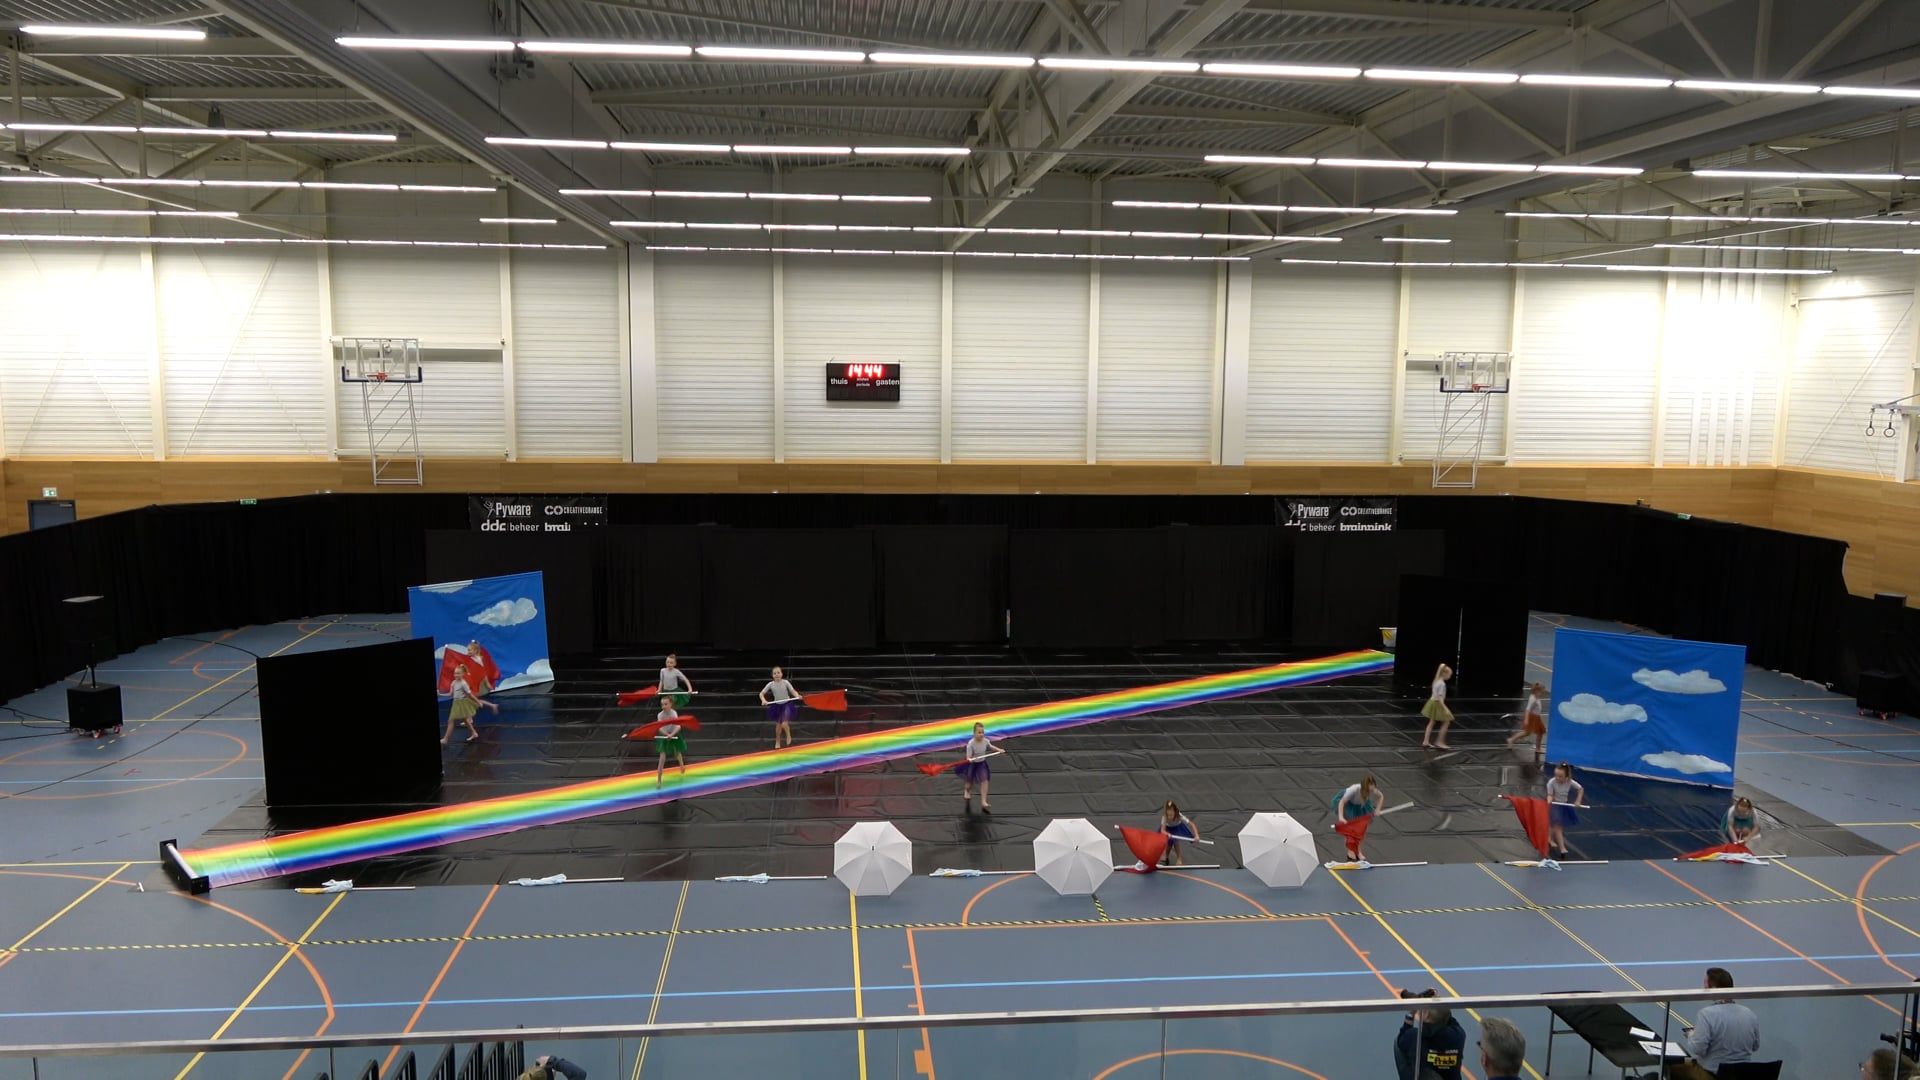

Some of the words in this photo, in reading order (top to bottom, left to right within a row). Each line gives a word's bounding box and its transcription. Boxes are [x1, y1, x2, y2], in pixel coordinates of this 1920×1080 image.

[830, 377, 848, 385] thuis
[875, 379, 900, 387] gasten
[495, 502, 532, 518] Pyware
[1297, 503, 1329, 519] Pyware
[481, 519, 506, 532] ddc
[509, 522, 540, 532] beheer
[1309, 523, 1336, 532] beheer
